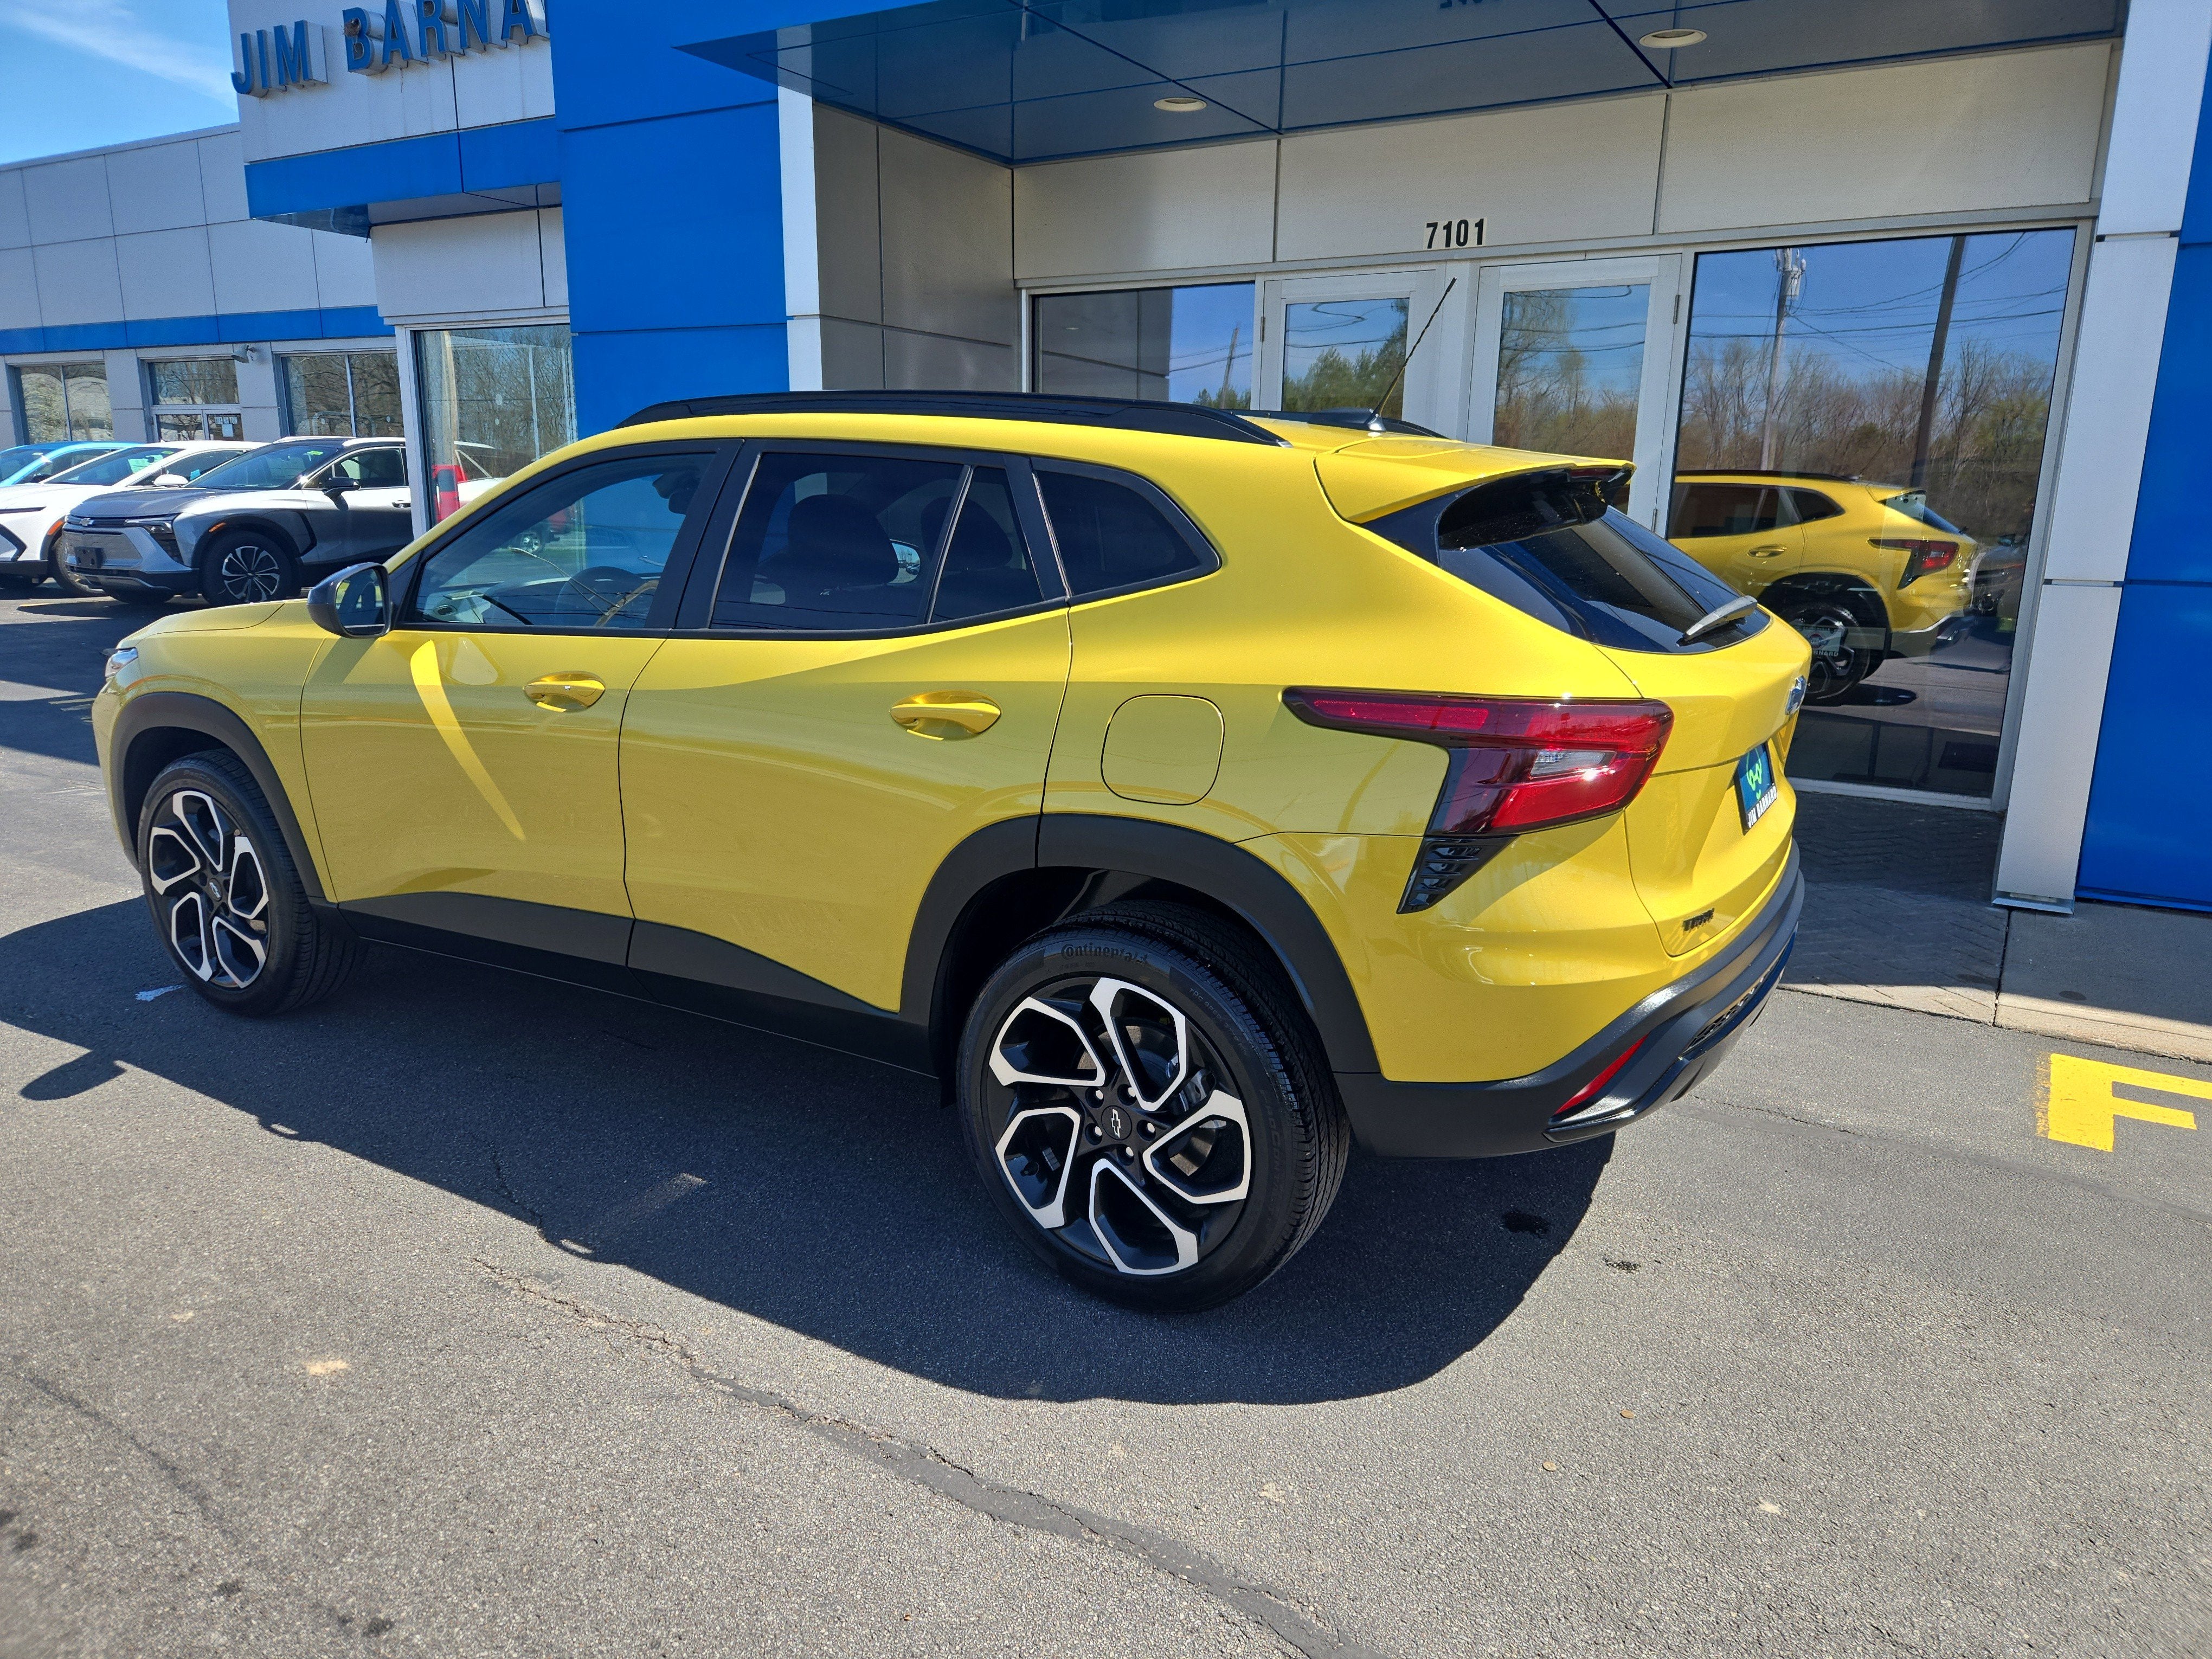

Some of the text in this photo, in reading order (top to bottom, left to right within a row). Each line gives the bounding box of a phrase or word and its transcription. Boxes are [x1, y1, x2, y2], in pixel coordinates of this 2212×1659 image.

[231, 0, 550, 96] JIM BARNA
[1426, 218, 1484, 249] 7101
[1747, 807, 1758, 828] JIM
[2047, 1053, 2212, 1153] F
